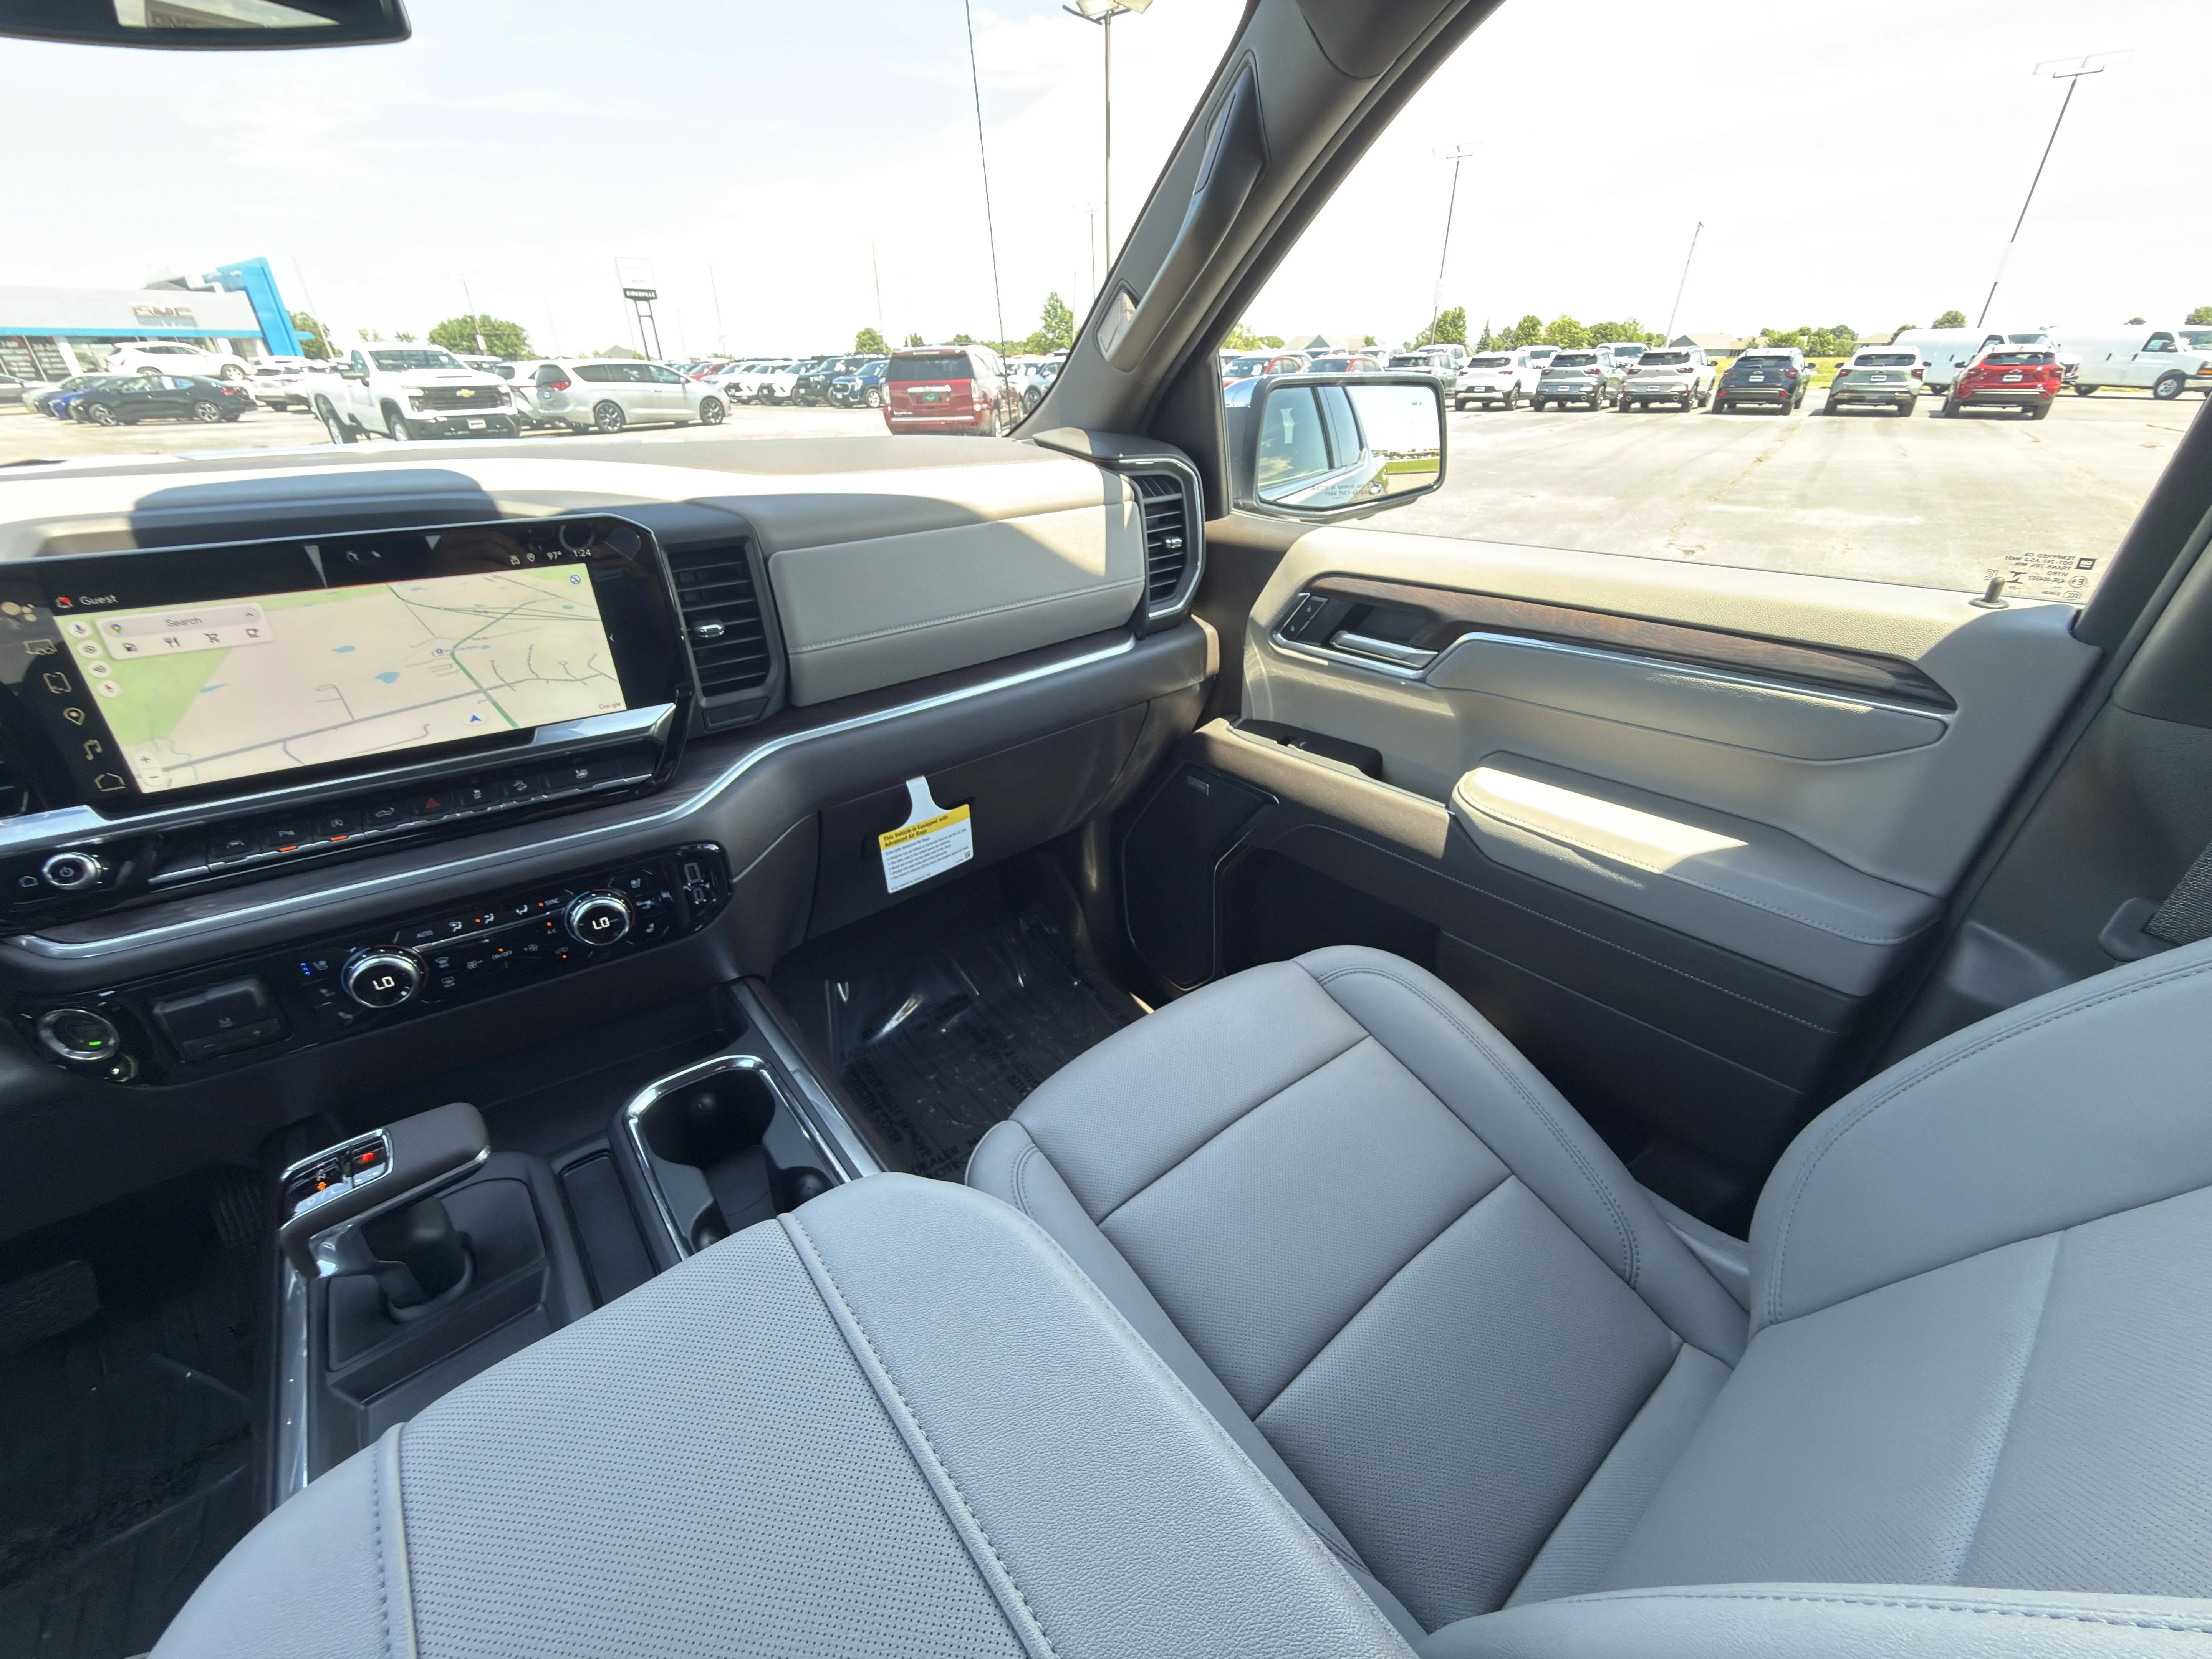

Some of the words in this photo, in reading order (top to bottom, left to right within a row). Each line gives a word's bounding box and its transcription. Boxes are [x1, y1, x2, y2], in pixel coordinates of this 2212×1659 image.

[130, 302, 194, 319] GMC
[573, 548, 591, 557] 1:24
[79, 594, 118, 605] Guest
[165, 617, 203, 627] Search
[894, 828, 911, 838] Vehicle
[917, 819, 938, 830] Equipped
[885, 836, 907, 847] Advanced
[544, 898, 560, 906] SYNC
[592, 917, 610, 930] LO
[416, 930, 433, 939] AUTO
[372, 976, 395, 990] LO
